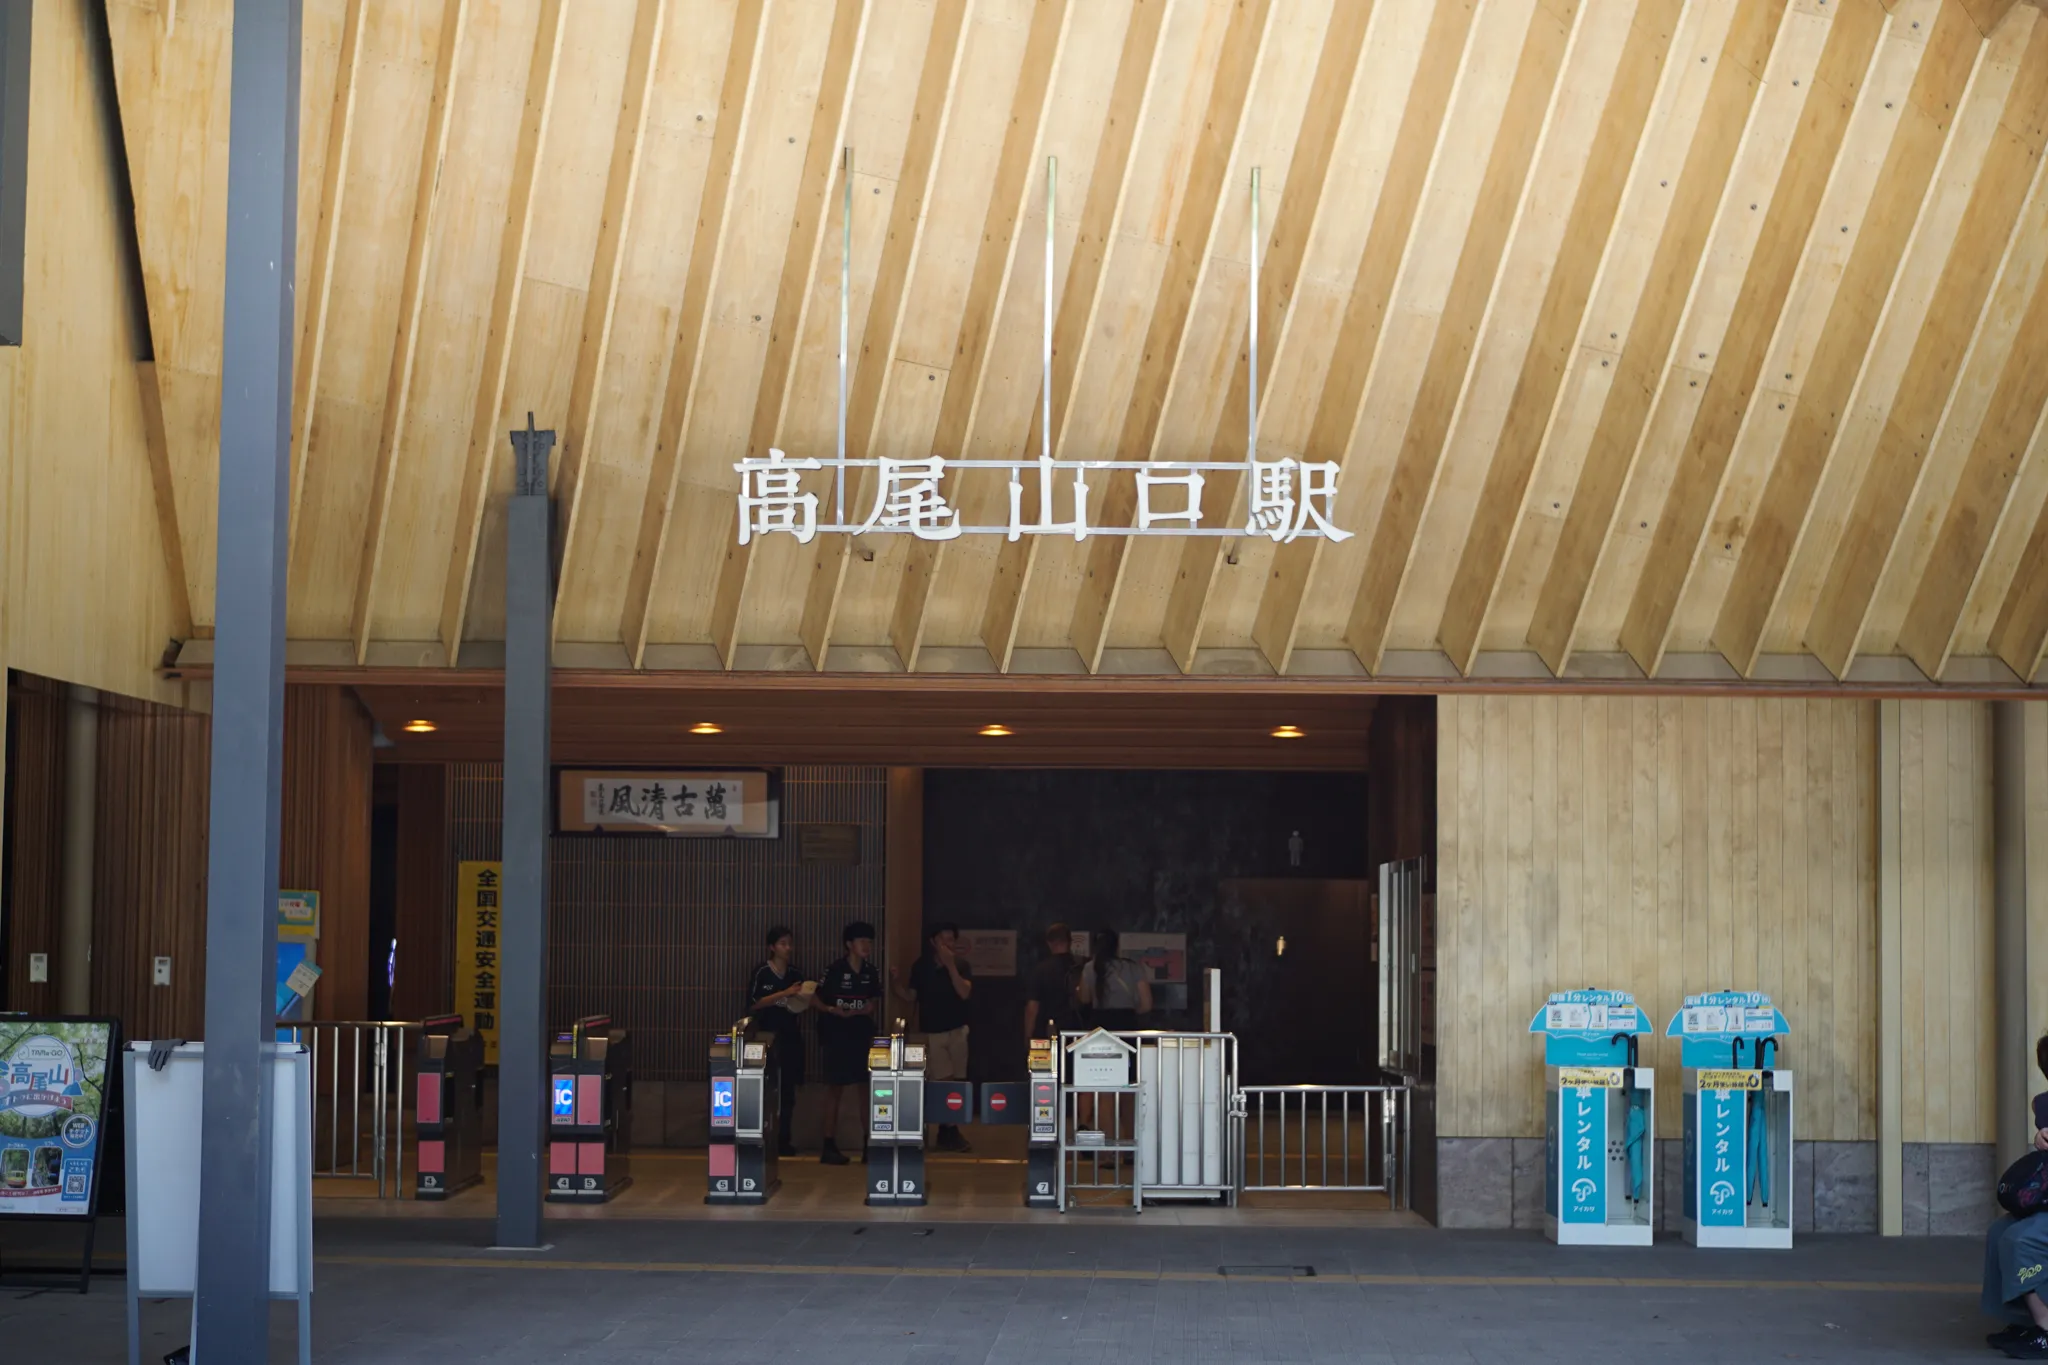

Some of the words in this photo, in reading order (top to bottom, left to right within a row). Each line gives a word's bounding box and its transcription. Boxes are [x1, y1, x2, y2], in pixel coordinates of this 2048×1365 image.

[733, 447, 1355, 546] 高尾山口駅
[474, 868, 498, 1031] 全国交通安全運動
[836, 998, 866, 1010] RedB
[11, 1061, 69, 1091] 高尾山
[555, 1089, 573, 1105] IC
[714, 1091, 732, 1107] IC
